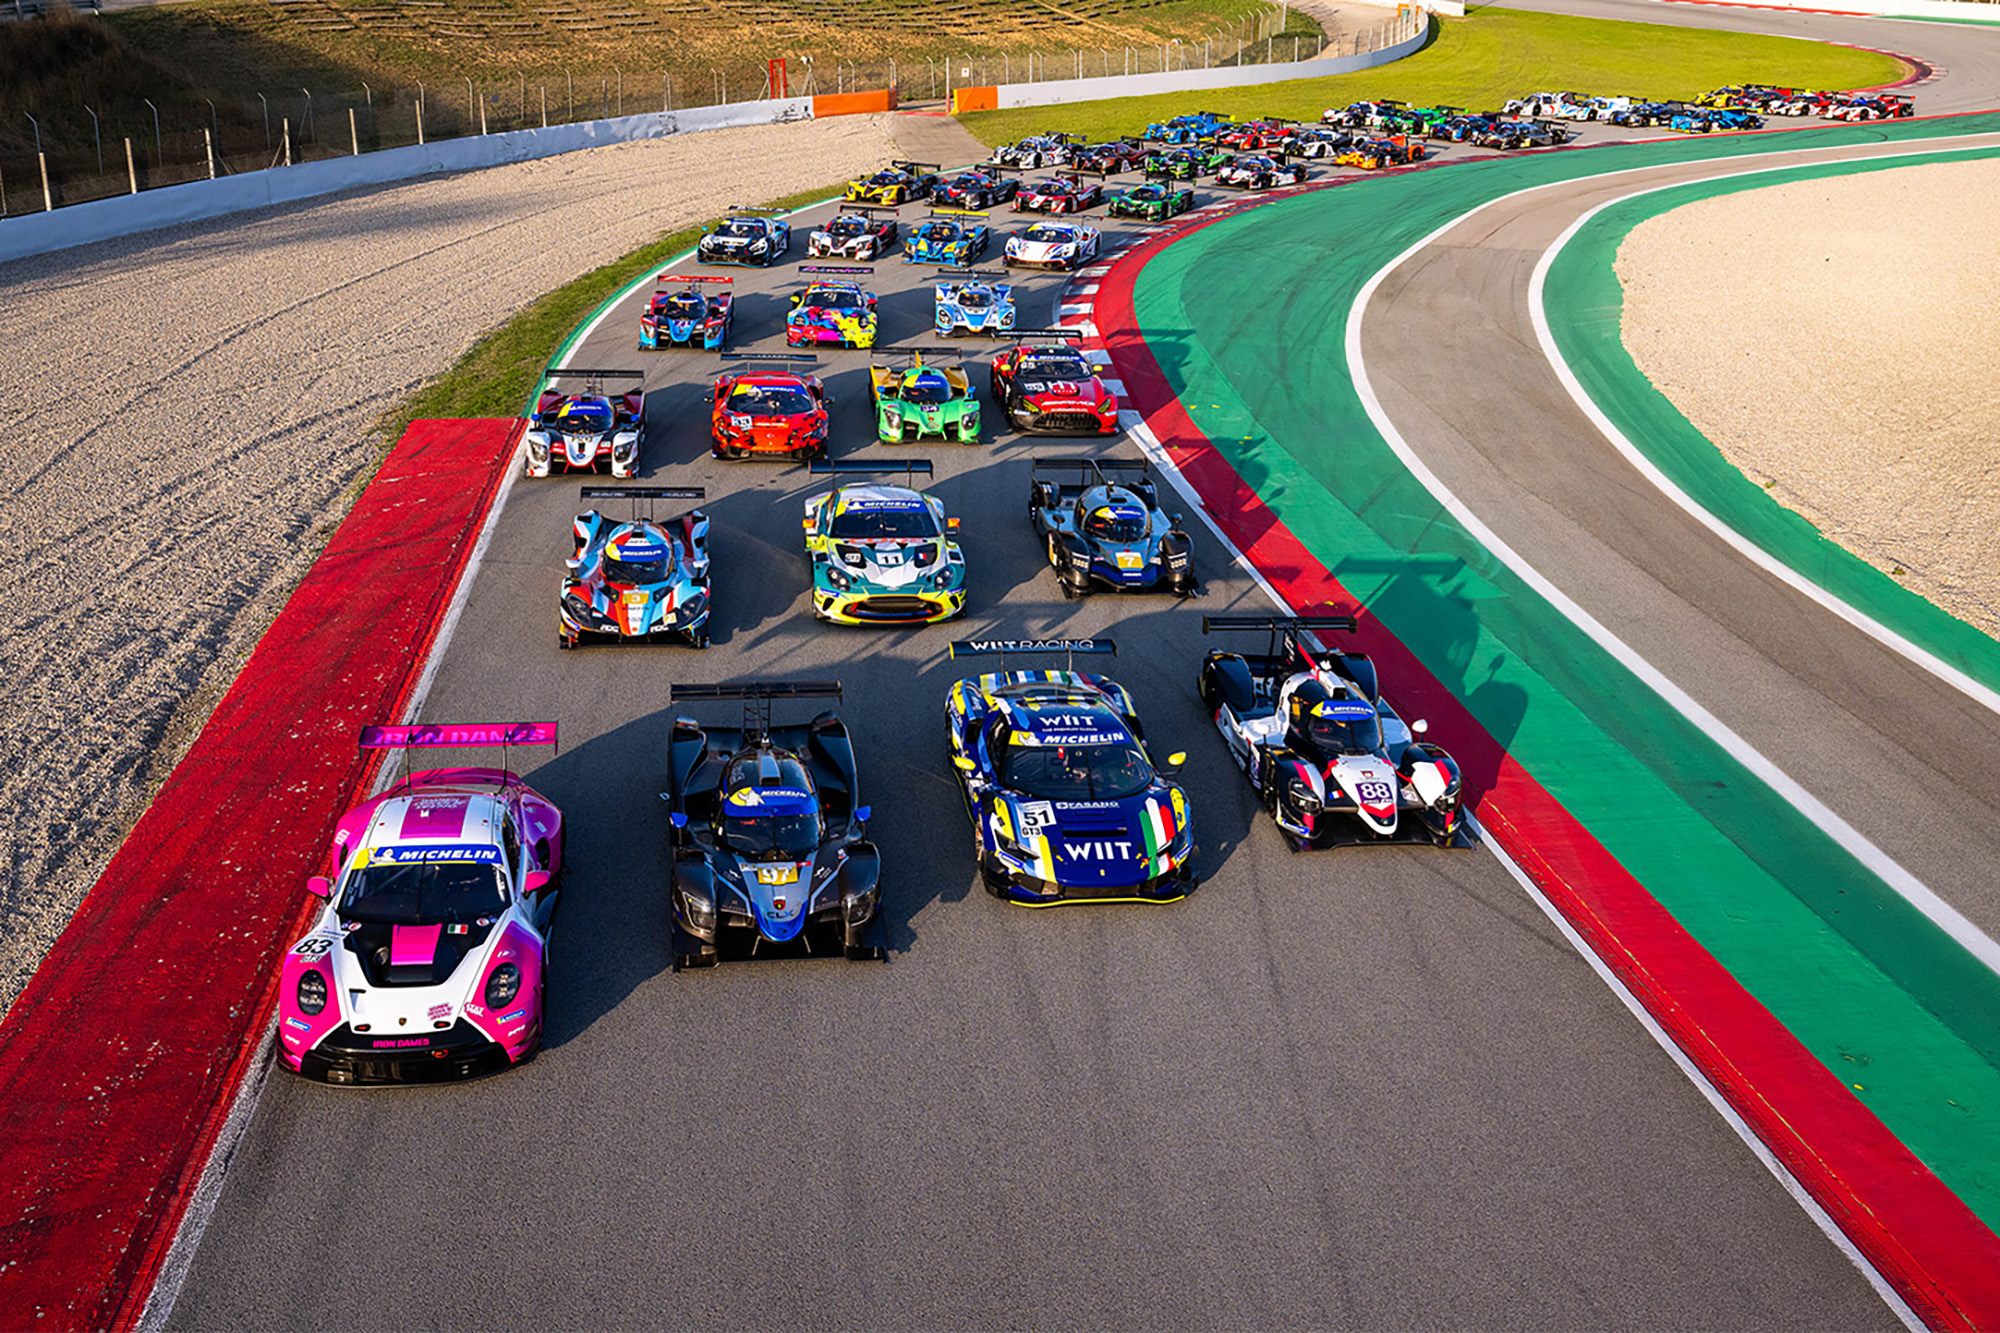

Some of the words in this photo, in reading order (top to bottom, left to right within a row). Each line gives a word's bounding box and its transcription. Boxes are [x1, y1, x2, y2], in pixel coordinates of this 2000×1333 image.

[881, 556, 900, 564] 11
[1123, 556, 1135, 567] 7
[630, 594, 641, 603] 3
[969, 640, 1017, 651] WIIT
[1019, 639, 1094, 650] RACING
[374, 731, 445, 744] IRON
[450, 728, 547, 743] DAMES
[1043, 732, 1125, 744] MICHELIN
[760, 790, 808, 798] MICHELIN
[1360, 783, 1391, 799] 88
[1023, 809, 1051, 827] 51
[1021, 826, 1042, 836] GT3
[397, 848, 498, 861] MICHELIN
[1063, 841, 1132, 861] WIIT
[761, 866, 794, 884] 97
[766, 909, 795, 919] CLX
[295, 938, 334, 954] 83
[372, 1040, 397, 1049] IRON
[397, 1037, 431, 1048] DAMES
